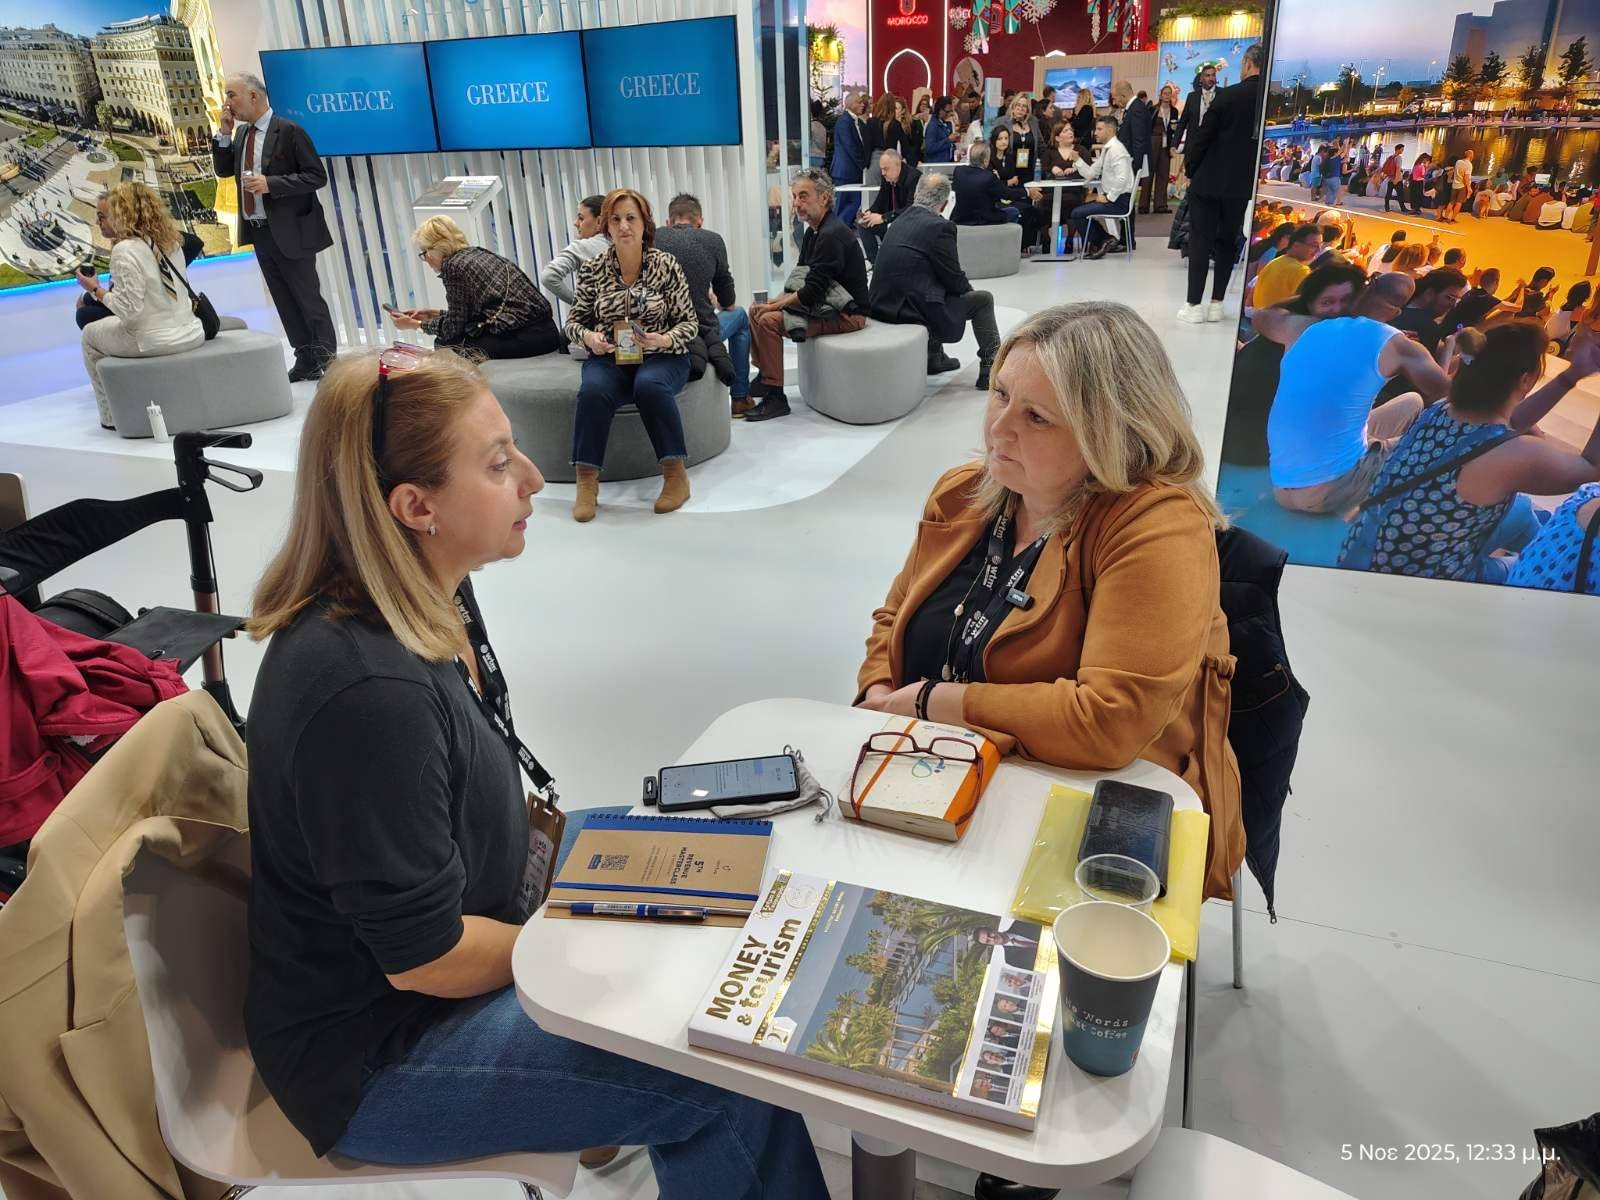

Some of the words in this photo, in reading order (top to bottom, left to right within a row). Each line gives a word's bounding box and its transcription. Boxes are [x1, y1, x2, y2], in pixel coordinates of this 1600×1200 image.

[887, 15, 929, 26] MOROCCO
[465, 81, 550, 106] GREECE
[619, 72, 702, 99] GREECE
[306, 90, 395, 114] GREECE
[996, 517, 1009, 539] wtm
[986, 566, 999, 589] wtm
[1006, 567, 1024, 588] wtm
[459, 603, 472, 624] wtm
[485, 652, 498, 672] wtm
[670, 846, 688, 885] MASTERCLASS
[680, 853, 695, 879] REVENUE
[694, 860, 705, 873] 5TH
[739, 918, 802, 1009] tourism
[705, 934, 768, 1020] MONEY
[736, 1013, 753, 1026] &
